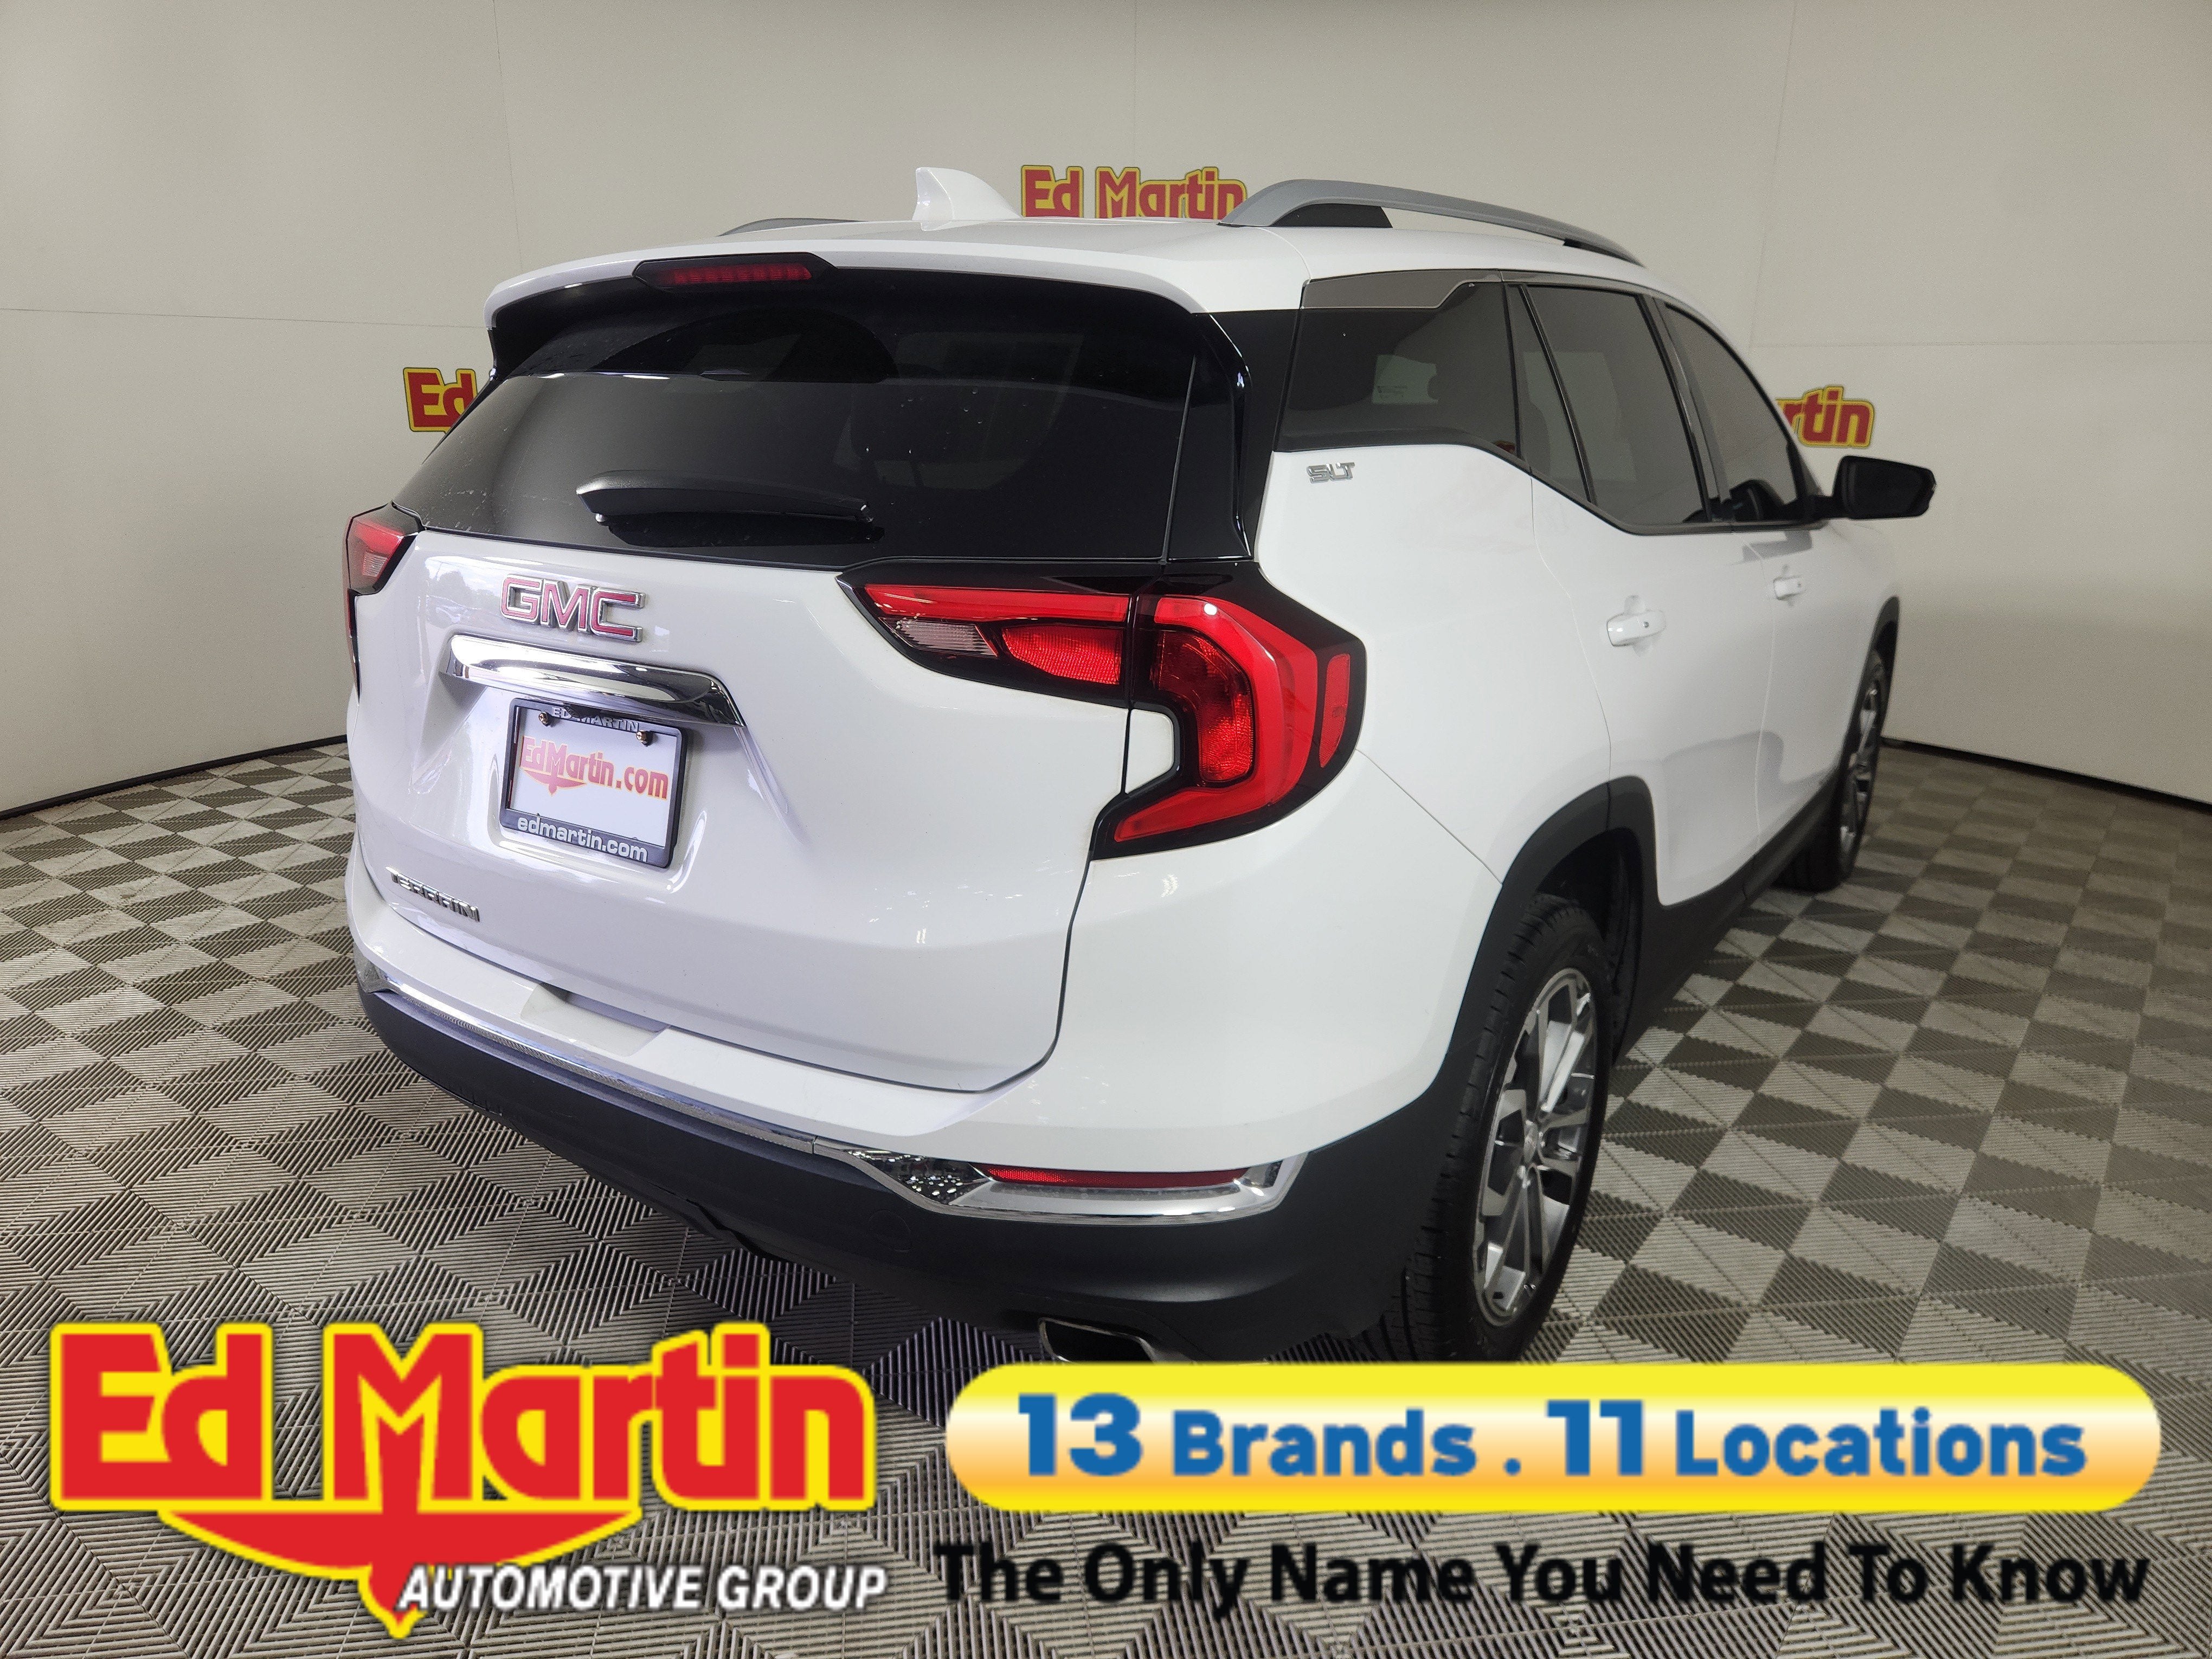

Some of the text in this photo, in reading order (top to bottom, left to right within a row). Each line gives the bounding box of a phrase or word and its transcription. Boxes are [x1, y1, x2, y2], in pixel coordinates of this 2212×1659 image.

[1022, 165, 1247, 220] Ed Martin
[404, 368, 478, 432] Ed
[1307, 461, 1355, 484] SLT
[500, 574, 646, 642] GMC
[519, 735, 670, 801] EdMartin.com
[517, 816, 649, 863] edmartin.com
[385, 866, 481, 923] TERRAIN
